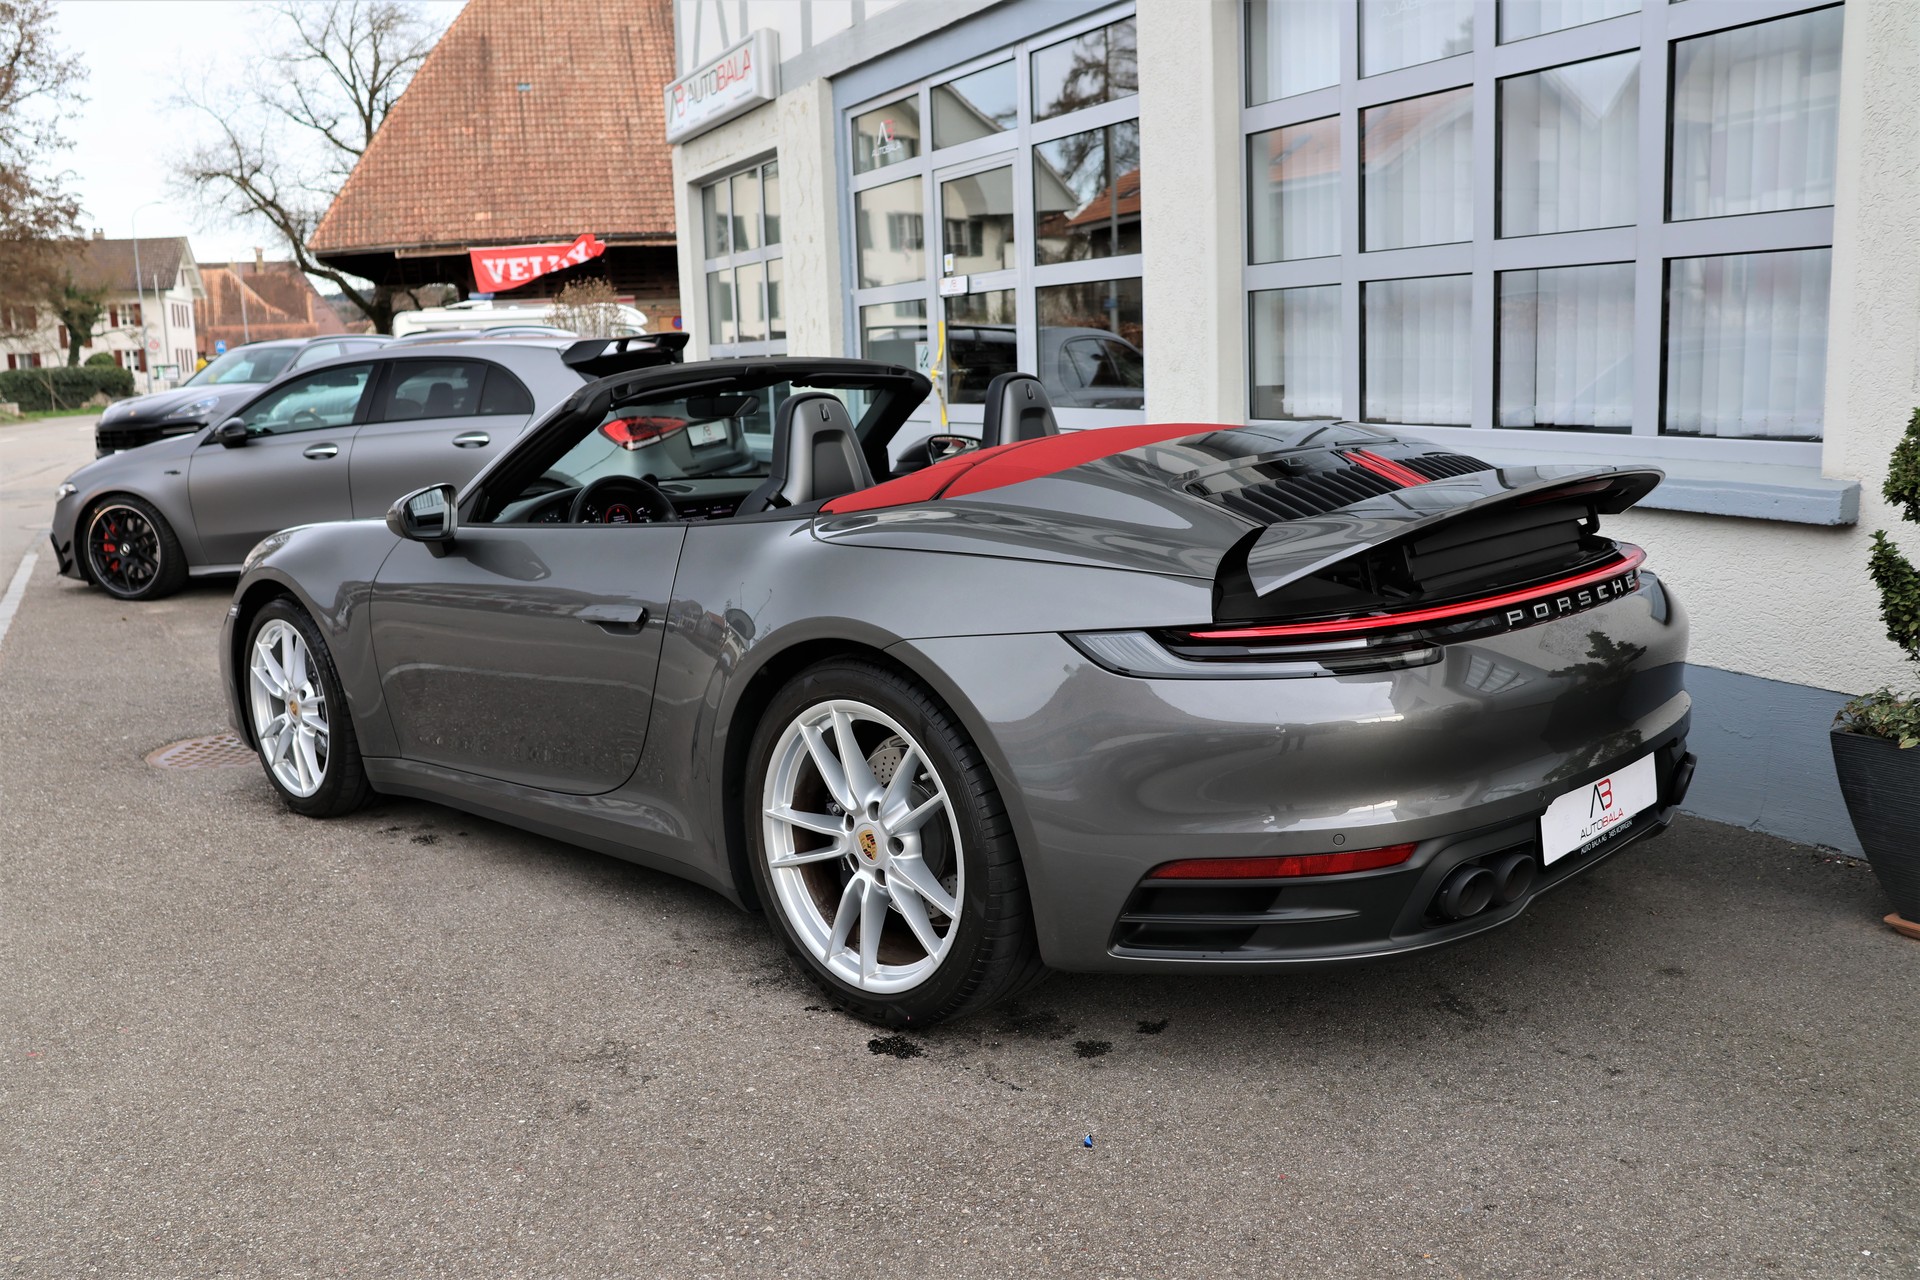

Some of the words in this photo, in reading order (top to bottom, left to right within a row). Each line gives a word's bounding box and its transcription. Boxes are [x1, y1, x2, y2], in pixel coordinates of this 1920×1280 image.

[687, 48, 752, 104] AUTOBALA
[1506, 574, 1637, 627] PORSCHE
[1580, 807, 1624, 840] AUTOBALA
